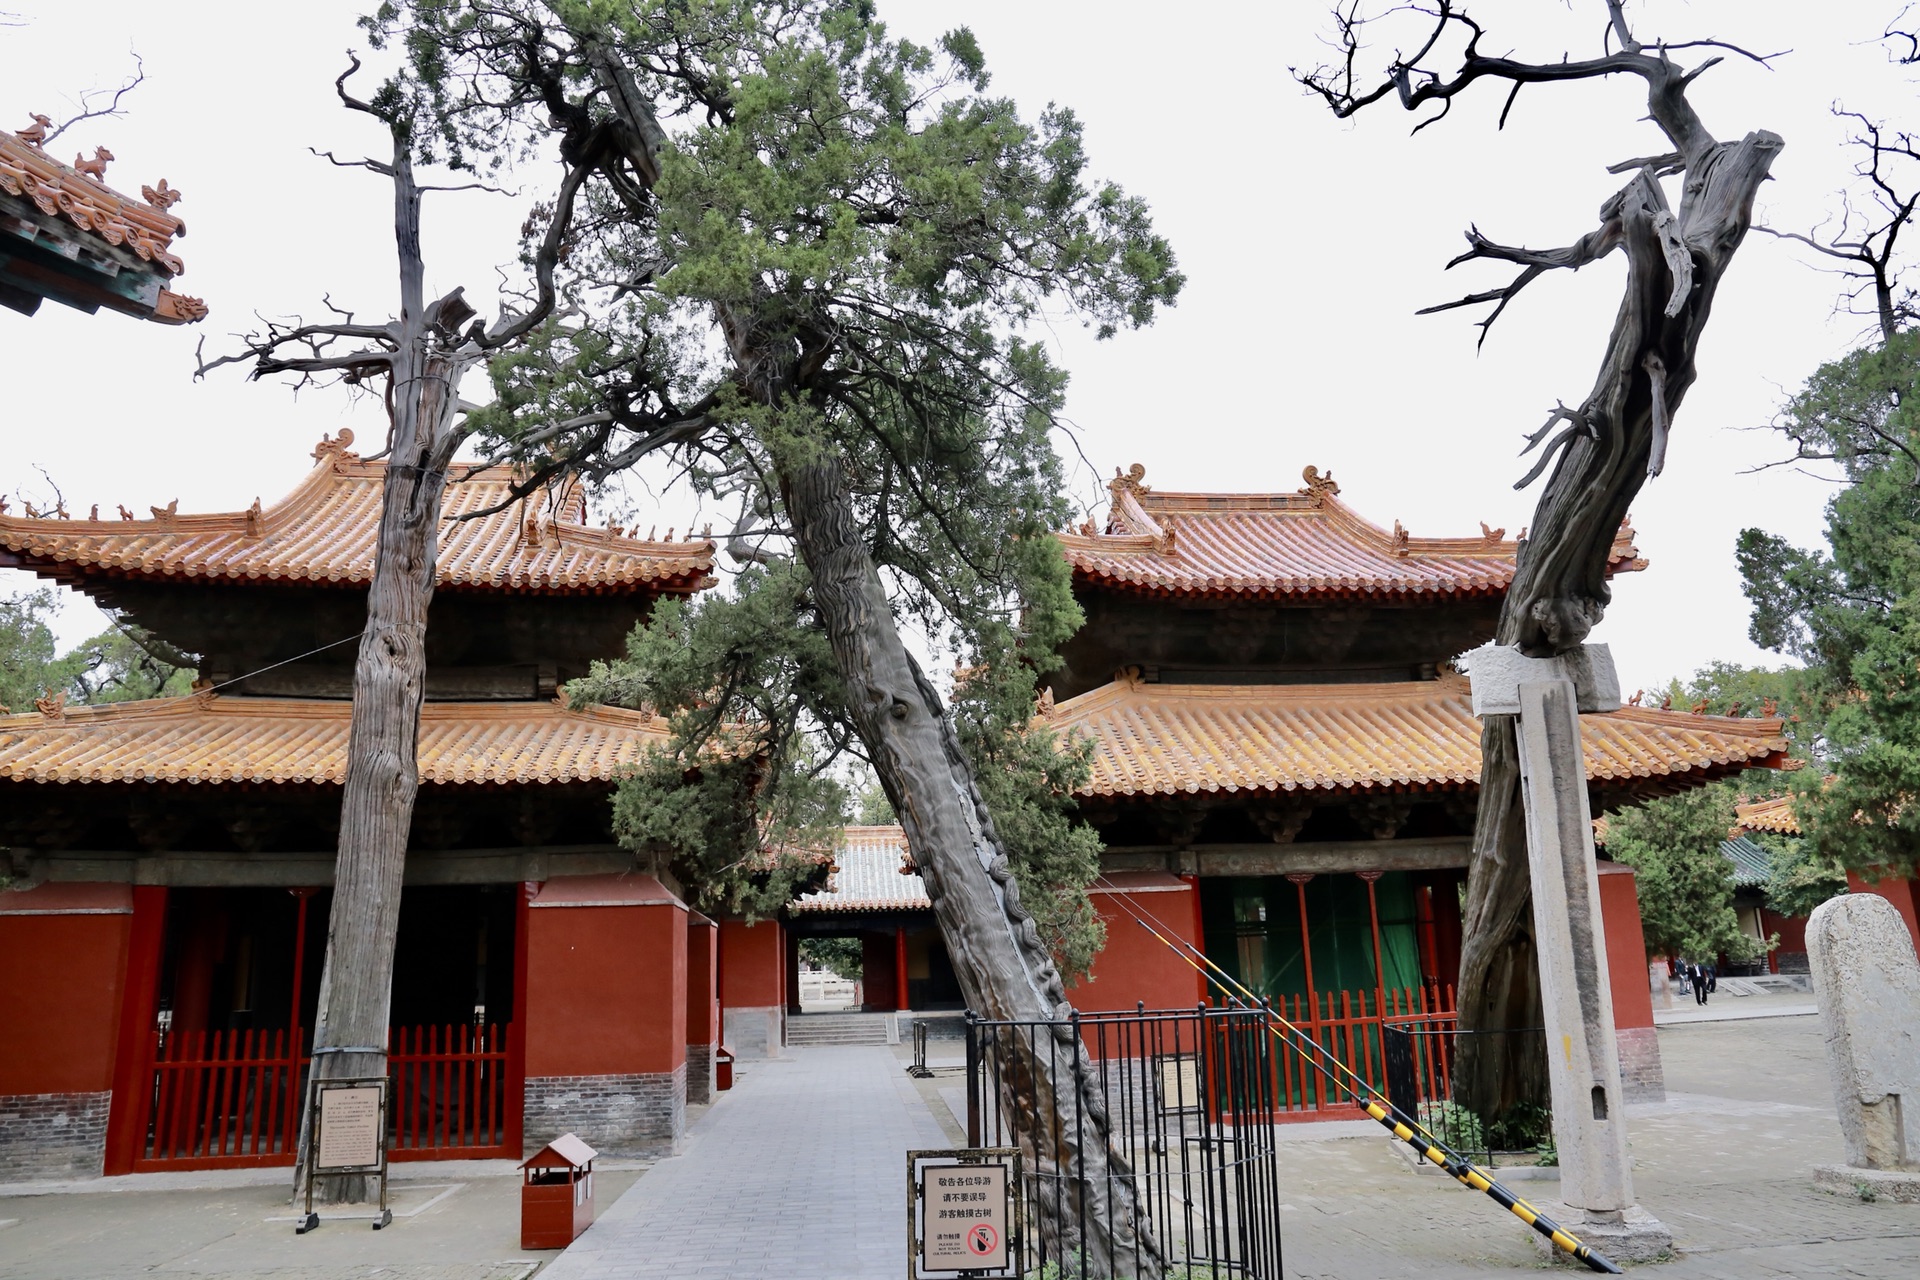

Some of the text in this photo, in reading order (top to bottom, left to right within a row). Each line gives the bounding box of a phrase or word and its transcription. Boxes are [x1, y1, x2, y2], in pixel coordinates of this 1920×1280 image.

[938, 1176, 991, 1186] 敬告各位导游
[943, 1193, 986, 1202] 请不要误导
[939, 1209, 992, 1218] 游客触摸古树
